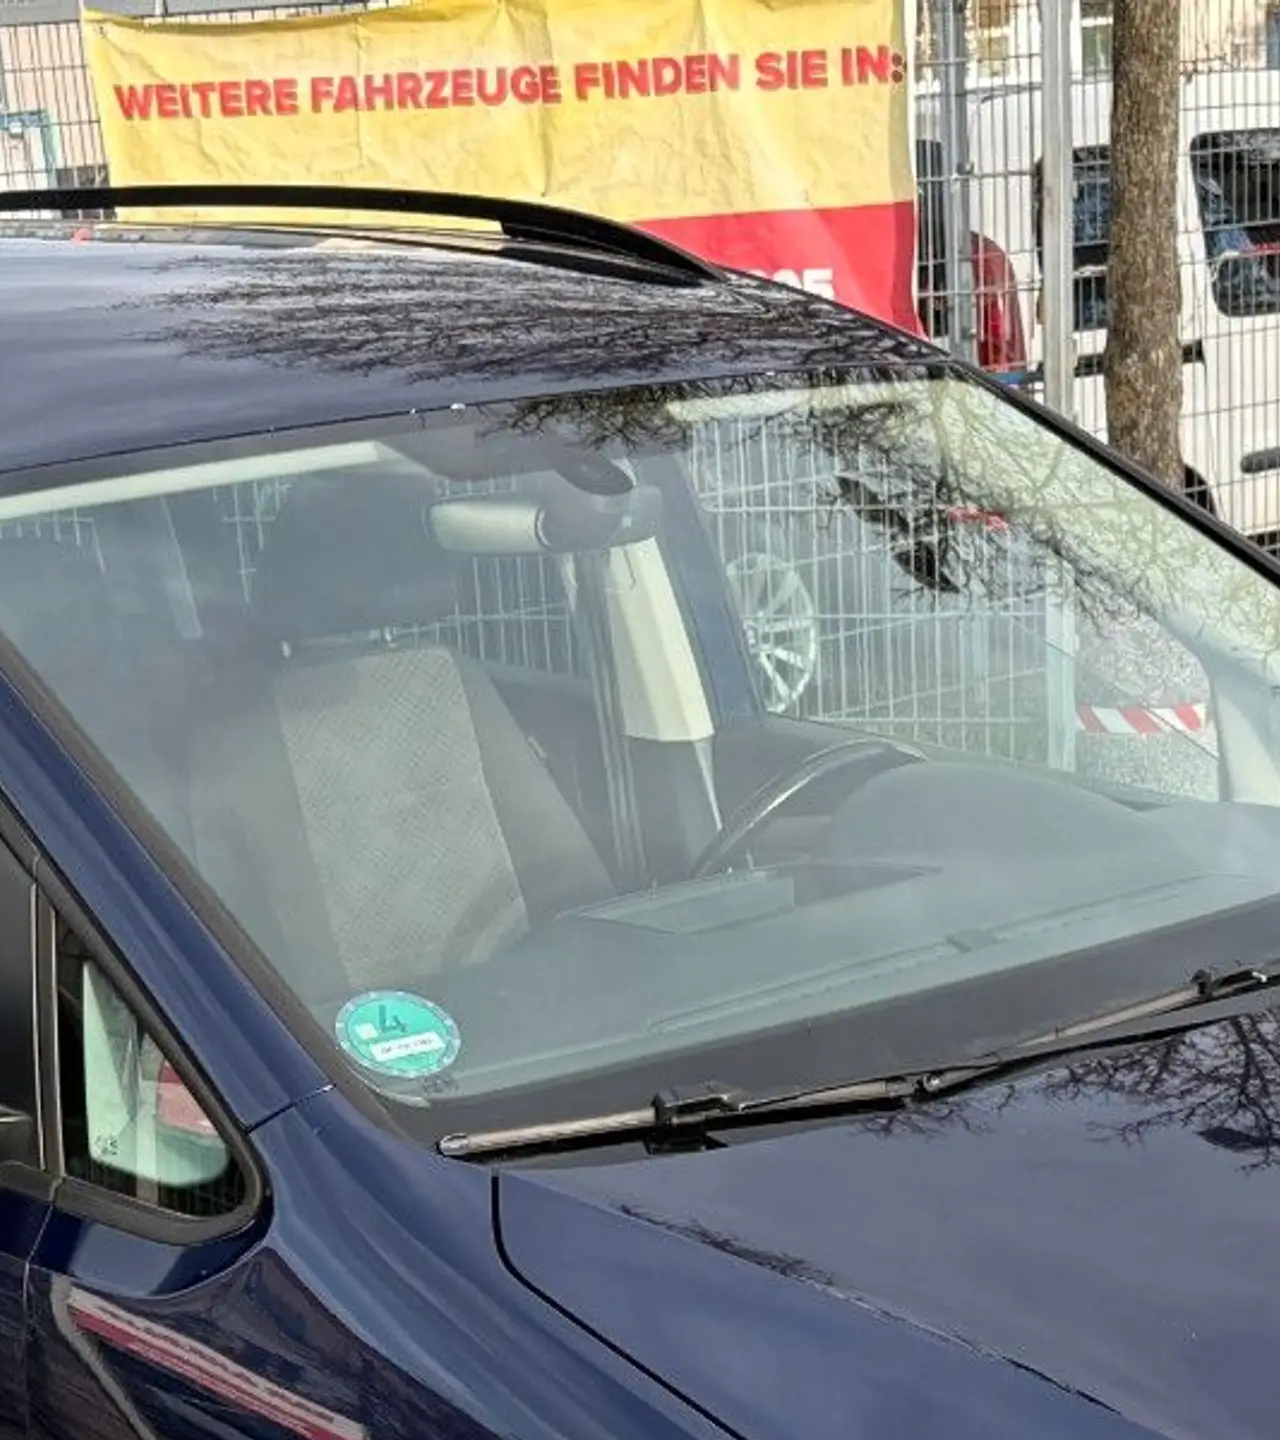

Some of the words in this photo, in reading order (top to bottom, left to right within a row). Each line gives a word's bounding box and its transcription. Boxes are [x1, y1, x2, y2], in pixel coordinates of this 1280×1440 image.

[113, 79, 299, 121] WEITERE
[310, 65, 563, 114] FAHRZEUGE
[573, 53, 741, 102] FINDEN
[754, 49, 829, 93] SIE
[840, 44, 908, 86] IN:
[378, 1003, 409, 1034] 4
